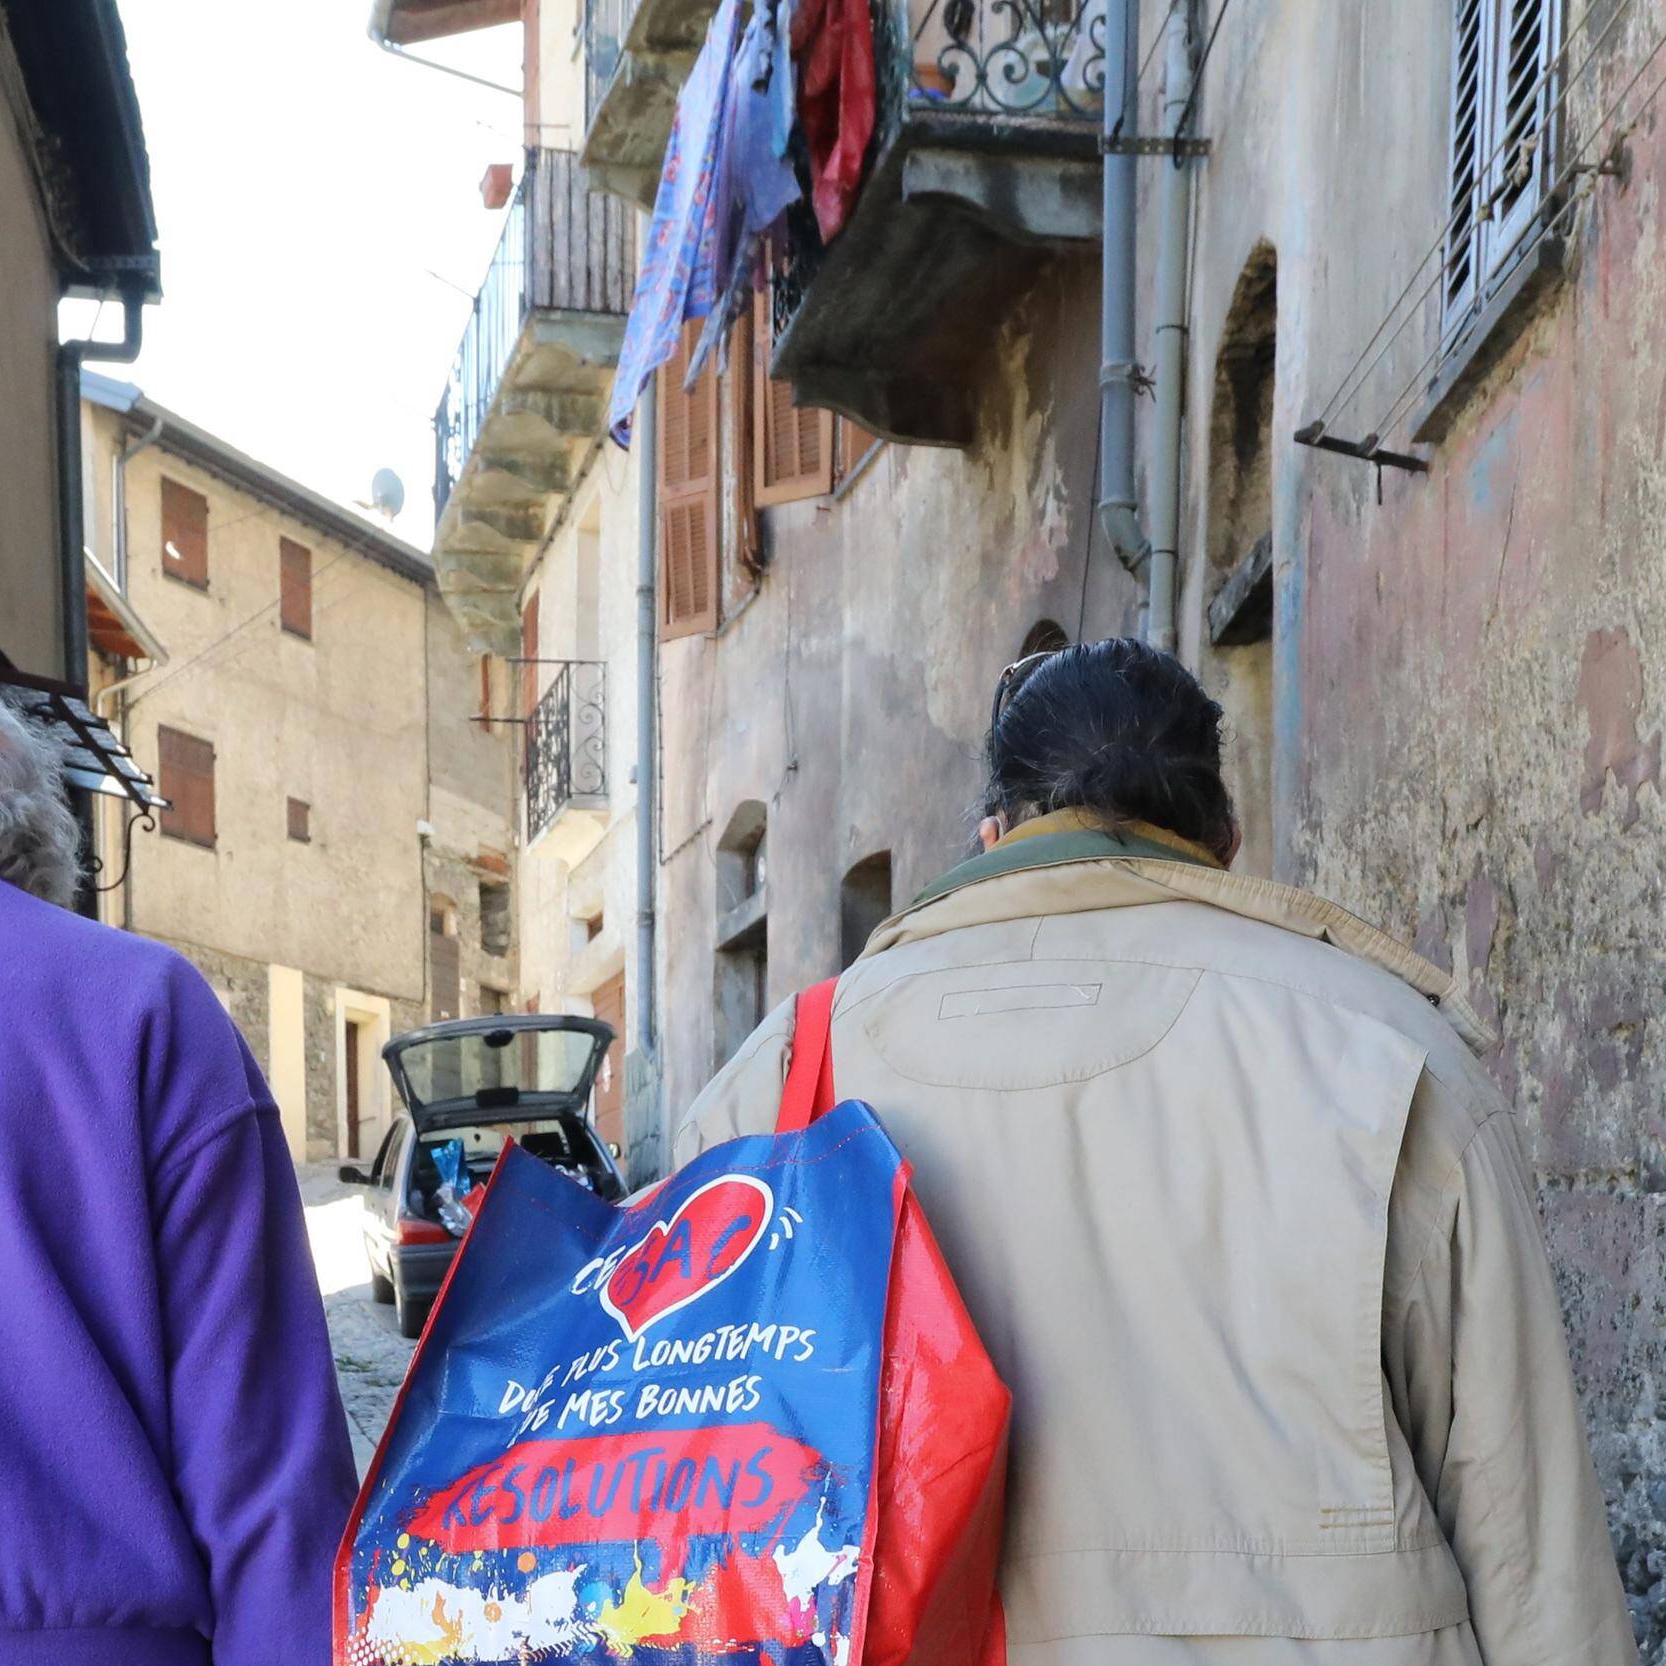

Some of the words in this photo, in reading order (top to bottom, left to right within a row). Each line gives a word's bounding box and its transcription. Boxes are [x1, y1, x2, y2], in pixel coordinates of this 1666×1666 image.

[632, 1322, 817, 1372] LONGTEMPS
[556, 1388, 625, 1431] MES
[635, 1374, 763, 1419] BONNES
